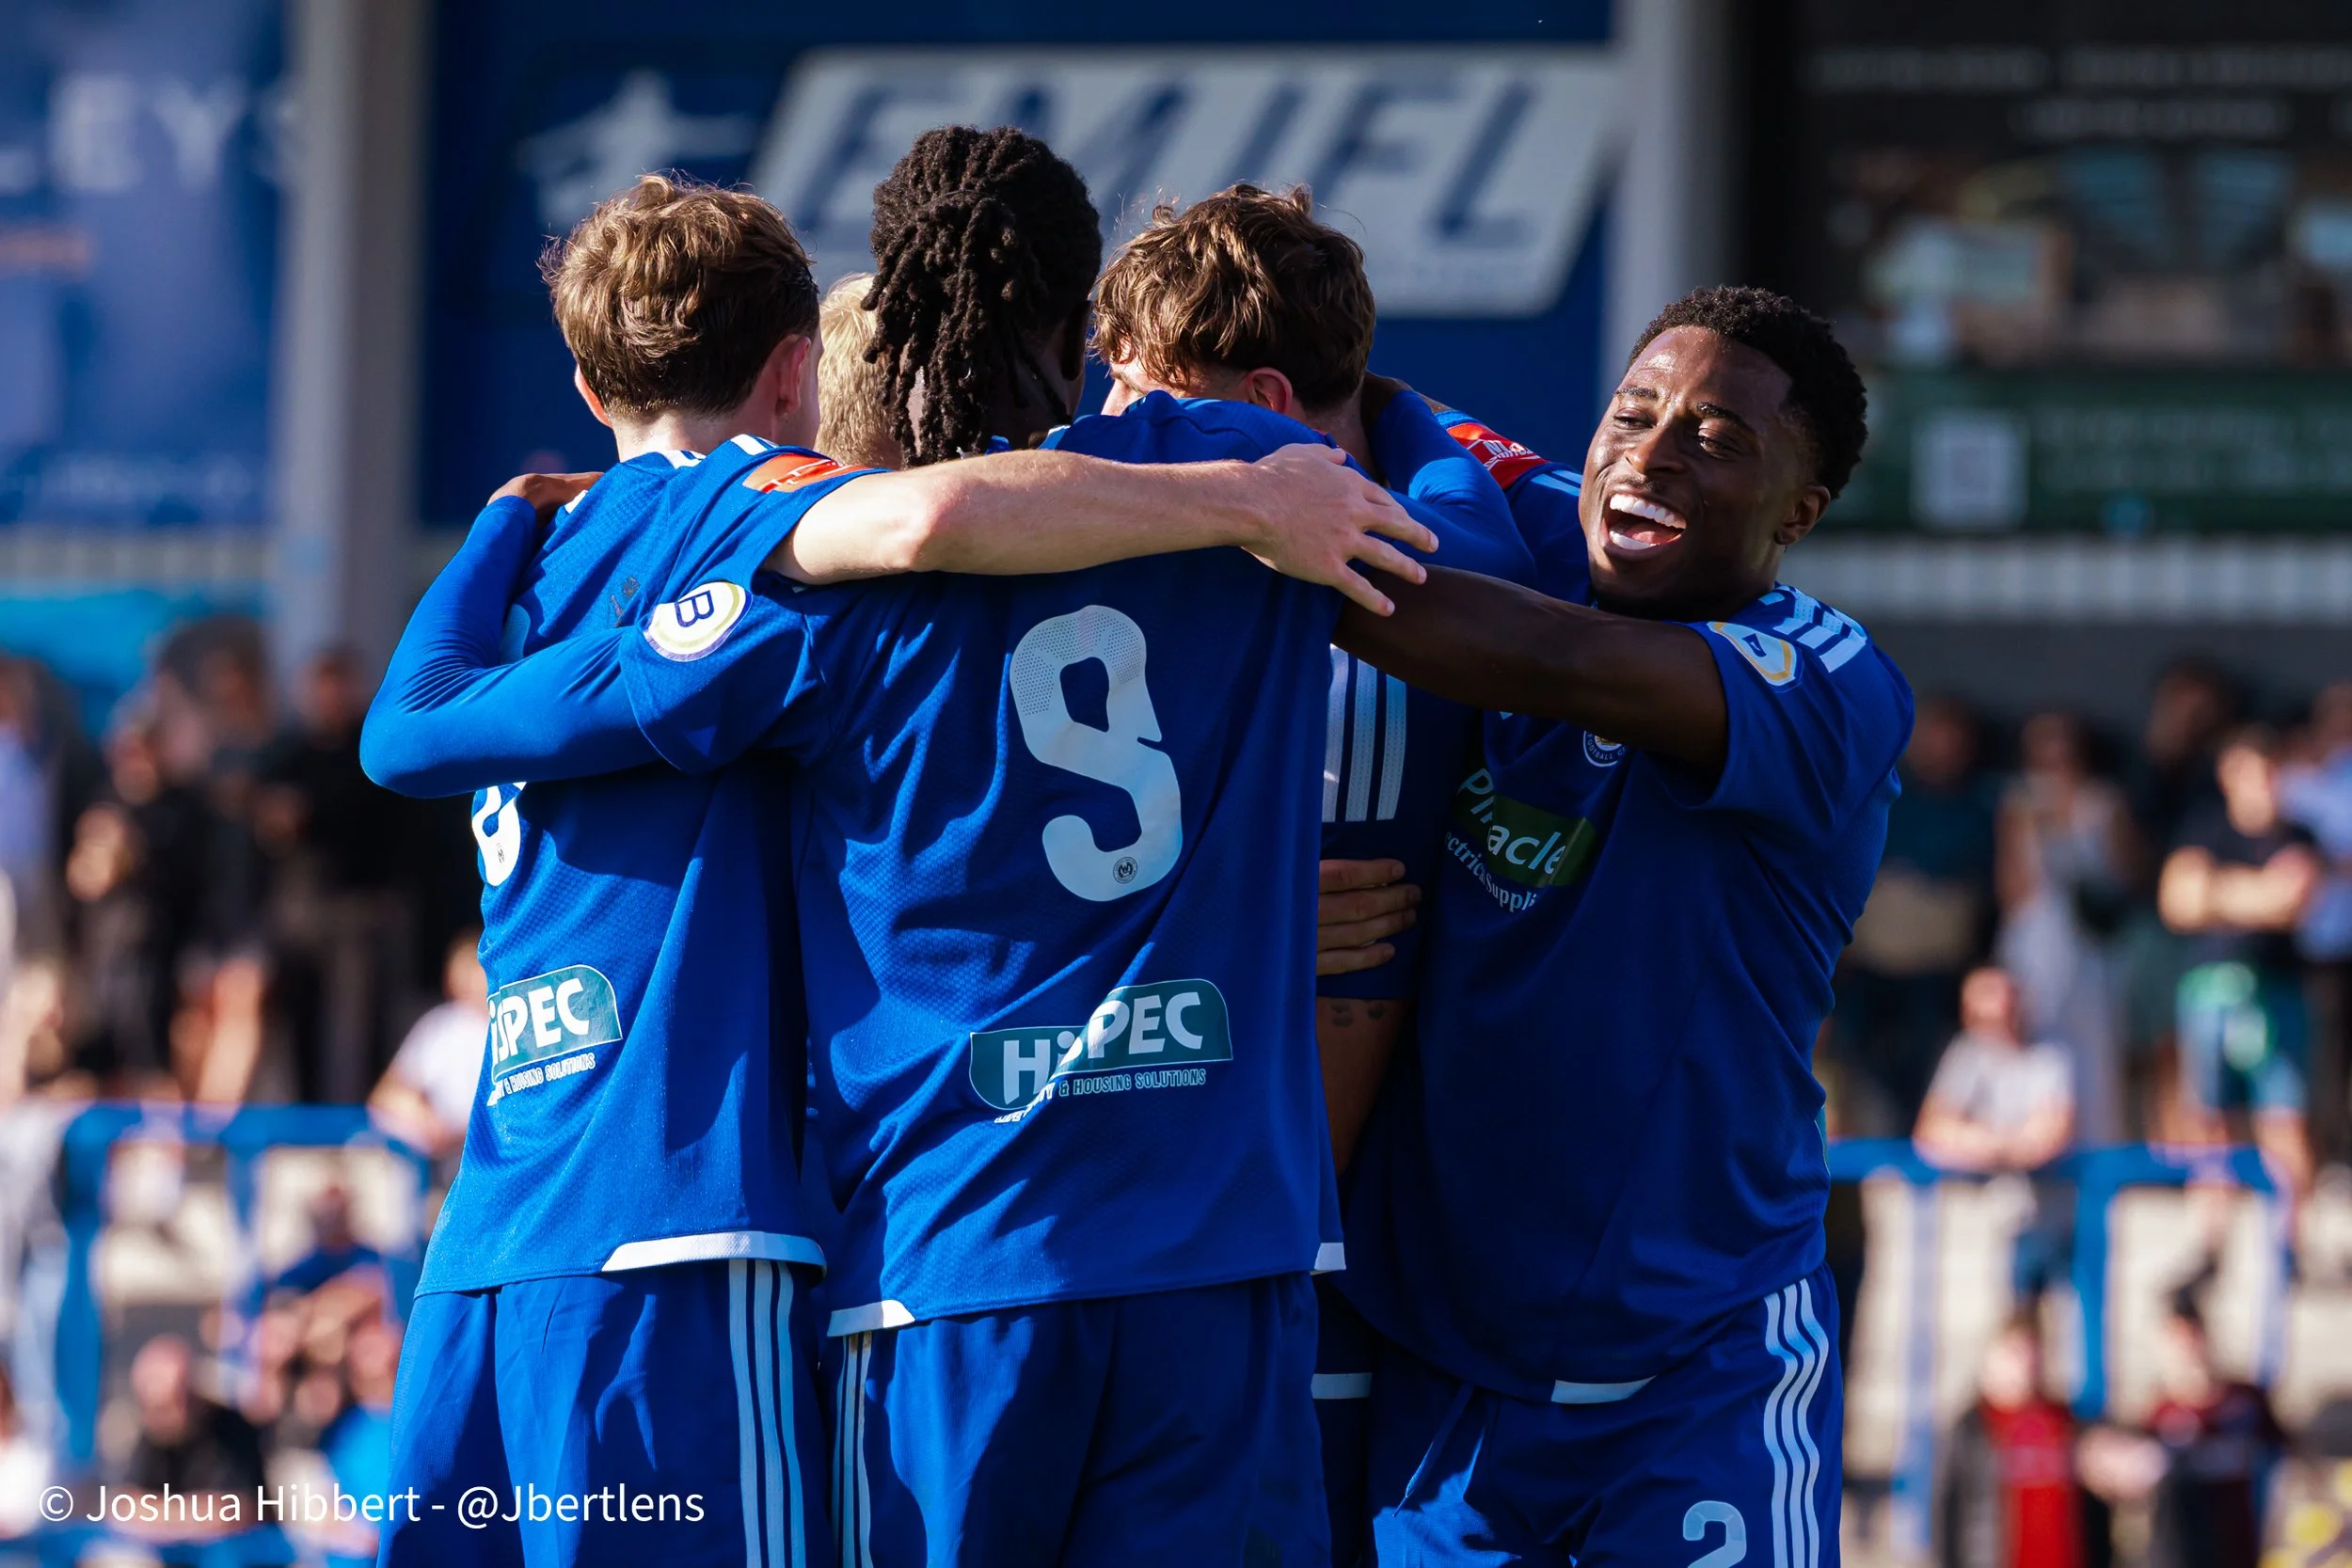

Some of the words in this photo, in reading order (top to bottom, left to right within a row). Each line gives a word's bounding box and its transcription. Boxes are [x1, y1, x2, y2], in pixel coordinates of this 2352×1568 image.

[1009, 605, 1183, 902] 9
[489, 977, 591, 1068] iSPEC
[1073, 1074, 1132, 1095] HOUSING
[1135, 1069, 1206, 1089] SOLUTIONS
